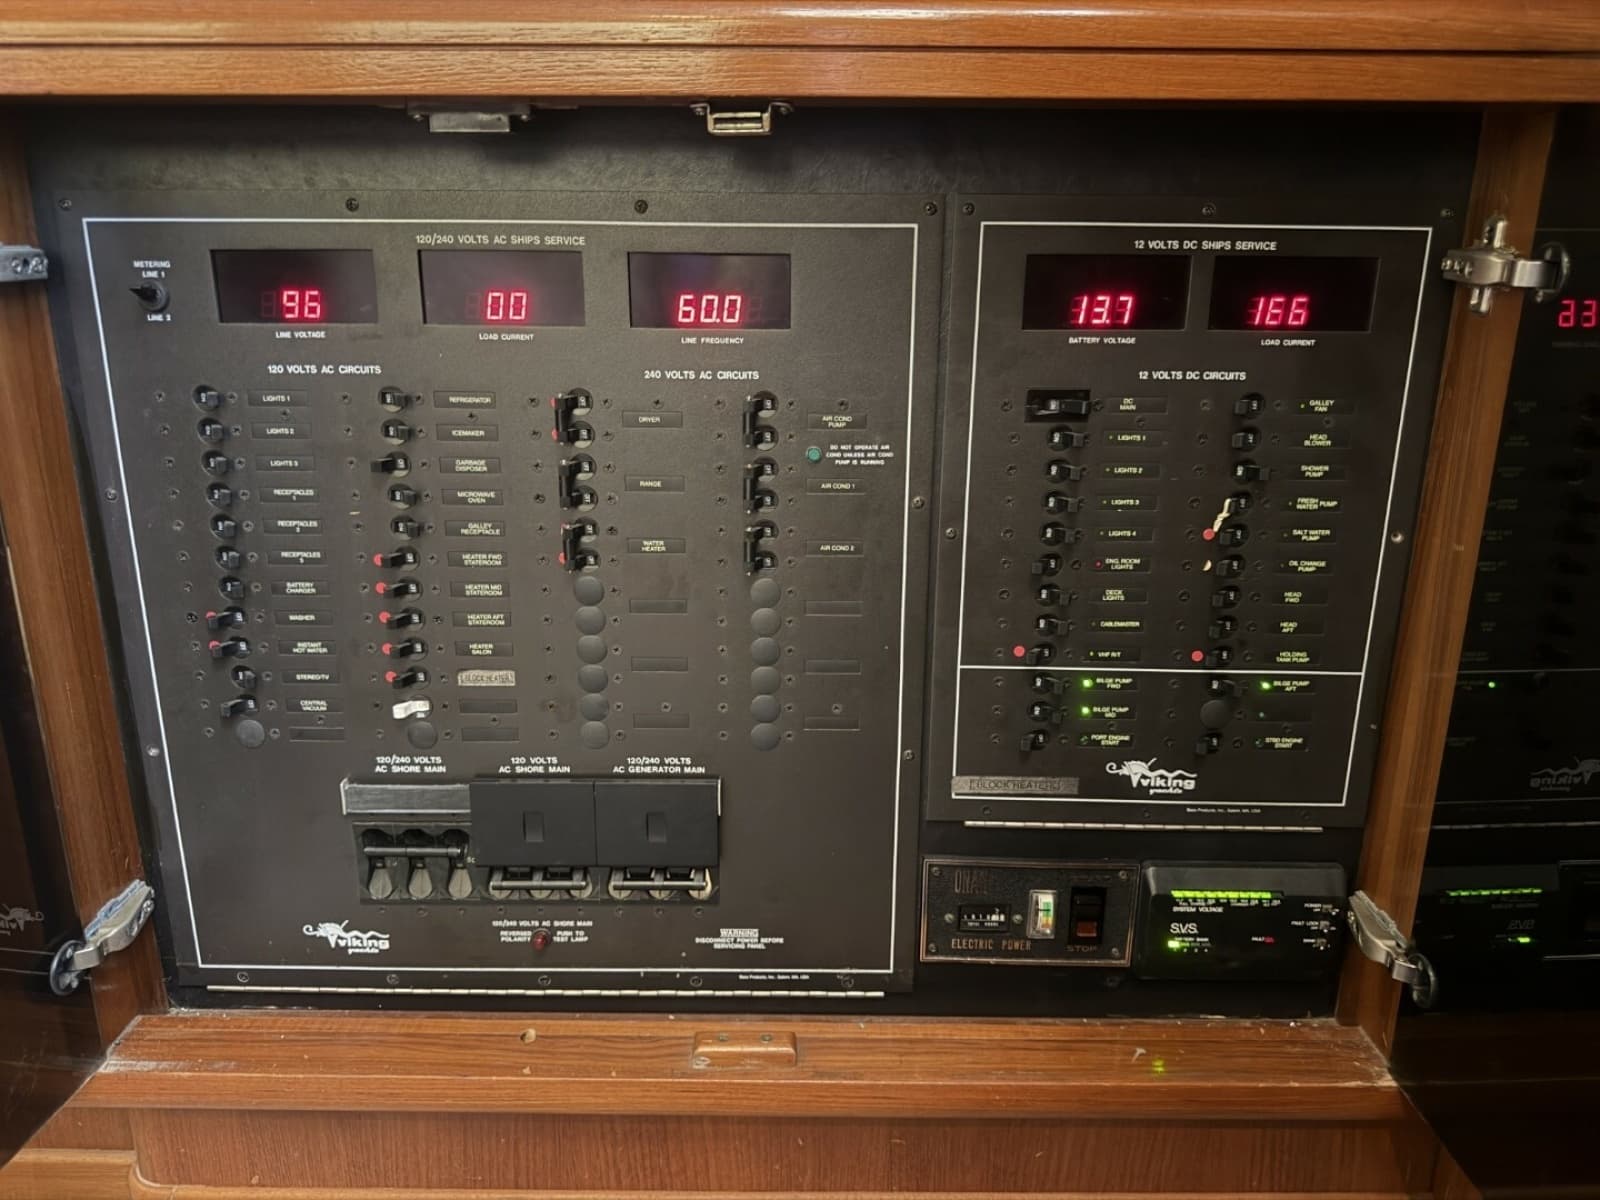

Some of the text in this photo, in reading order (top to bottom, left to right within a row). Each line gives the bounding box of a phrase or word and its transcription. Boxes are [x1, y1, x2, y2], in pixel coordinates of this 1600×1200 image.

[416, 235, 586, 246] 120/240 VOLTS AC SHIPS SERVICE
[1134, 240, 1277, 250] 12 VOLTS DC SHIPS SERVICE
[282, 290, 321, 319] 96
[487, 292, 527, 320] 00
[677, 294, 742, 323] 60.0
[1078, 296, 1133, 325] 13.7
[267, 365, 381, 375] 120 VOLTS AC CIRCUITS
[644, 370, 760, 380] 240 VOLTS AC CIRCUITS
[1138, 371, 1247, 381] 12 VOLTS DC CIRCUITS
[640, 480, 662, 488] RANGE
[460, 528, 500, 536] RECEPTACLE
[286, 581, 314, 589] BATTERY
[465, 589, 503, 597] STATEROOM
[375, 755, 442, 765] 120/240 VOLTS
[627, 756, 692, 765] 120/240 VOLTS
[374, 765, 447, 773] AC SHORE MAIN
[548, 766, 571, 774] MAIN
[628, 766, 681, 774] GENERATOR
[683, 766, 705, 774] MAIN
[720, 928, 759, 938] WARNING
[951, 938, 1032, 951] ELECTRIC POWER
